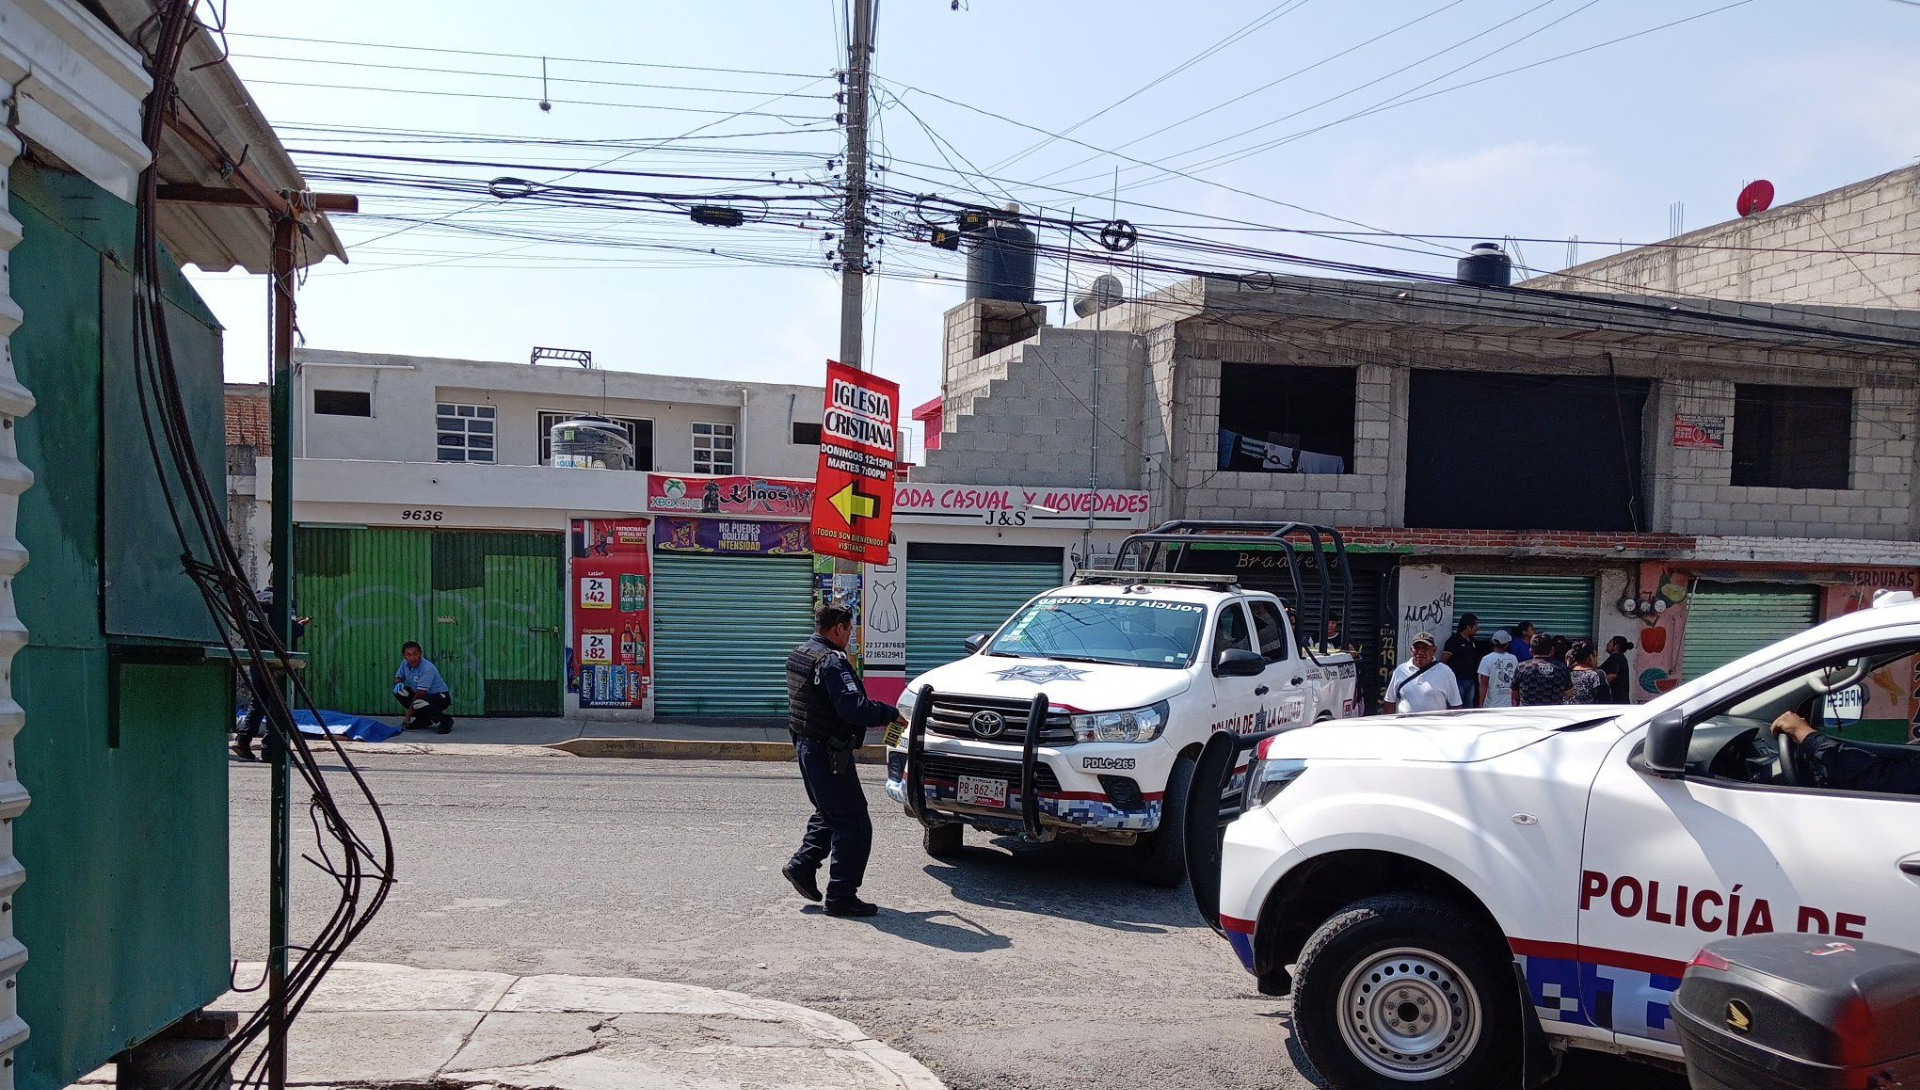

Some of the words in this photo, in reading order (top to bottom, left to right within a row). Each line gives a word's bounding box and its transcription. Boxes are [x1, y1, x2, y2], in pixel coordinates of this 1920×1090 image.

[834, 382, 890, 419] IGLESIA
[825, 411, 893, 448] CRISTIANA
[821, 443, 863, 462] DOMINGOS
[865, 455, 893, 470] 12:15PM
[827, 457, 860, 473] MARTES
[862, 466, 887, 480] 7:00PM
[893, 489, 935, 508] ODA
[941, 489, 1013, 509] CASUAL
[1024, 492, 1037, 509] Y
[1043, 492, 1149, 513] NOVEDADES
[401, 510, 443, 521] 9636
[985, 510, 1026, 526] J&S
[719, 522, 729, 532] NO
[732, 522, 761, 534] PUEDES
[722, 532, 748, 541] OCULTAR
[750, 534, 759, 542] TU
[718, 540, 761, 551] INTENSIDAD
[585, 591, 605, 602] $42
[585, 648, 605, 659] $82
[1381, 649, 1395, 666] 19
[1242, 714, 1254, 734] DE
[1267, 708, 1276, 728] LA
[1083, 756, 1136, 769] PDLC-265
[1580, 869, 1775, 937] POLICÍA
[1796, 905, 1867, 940] DE
